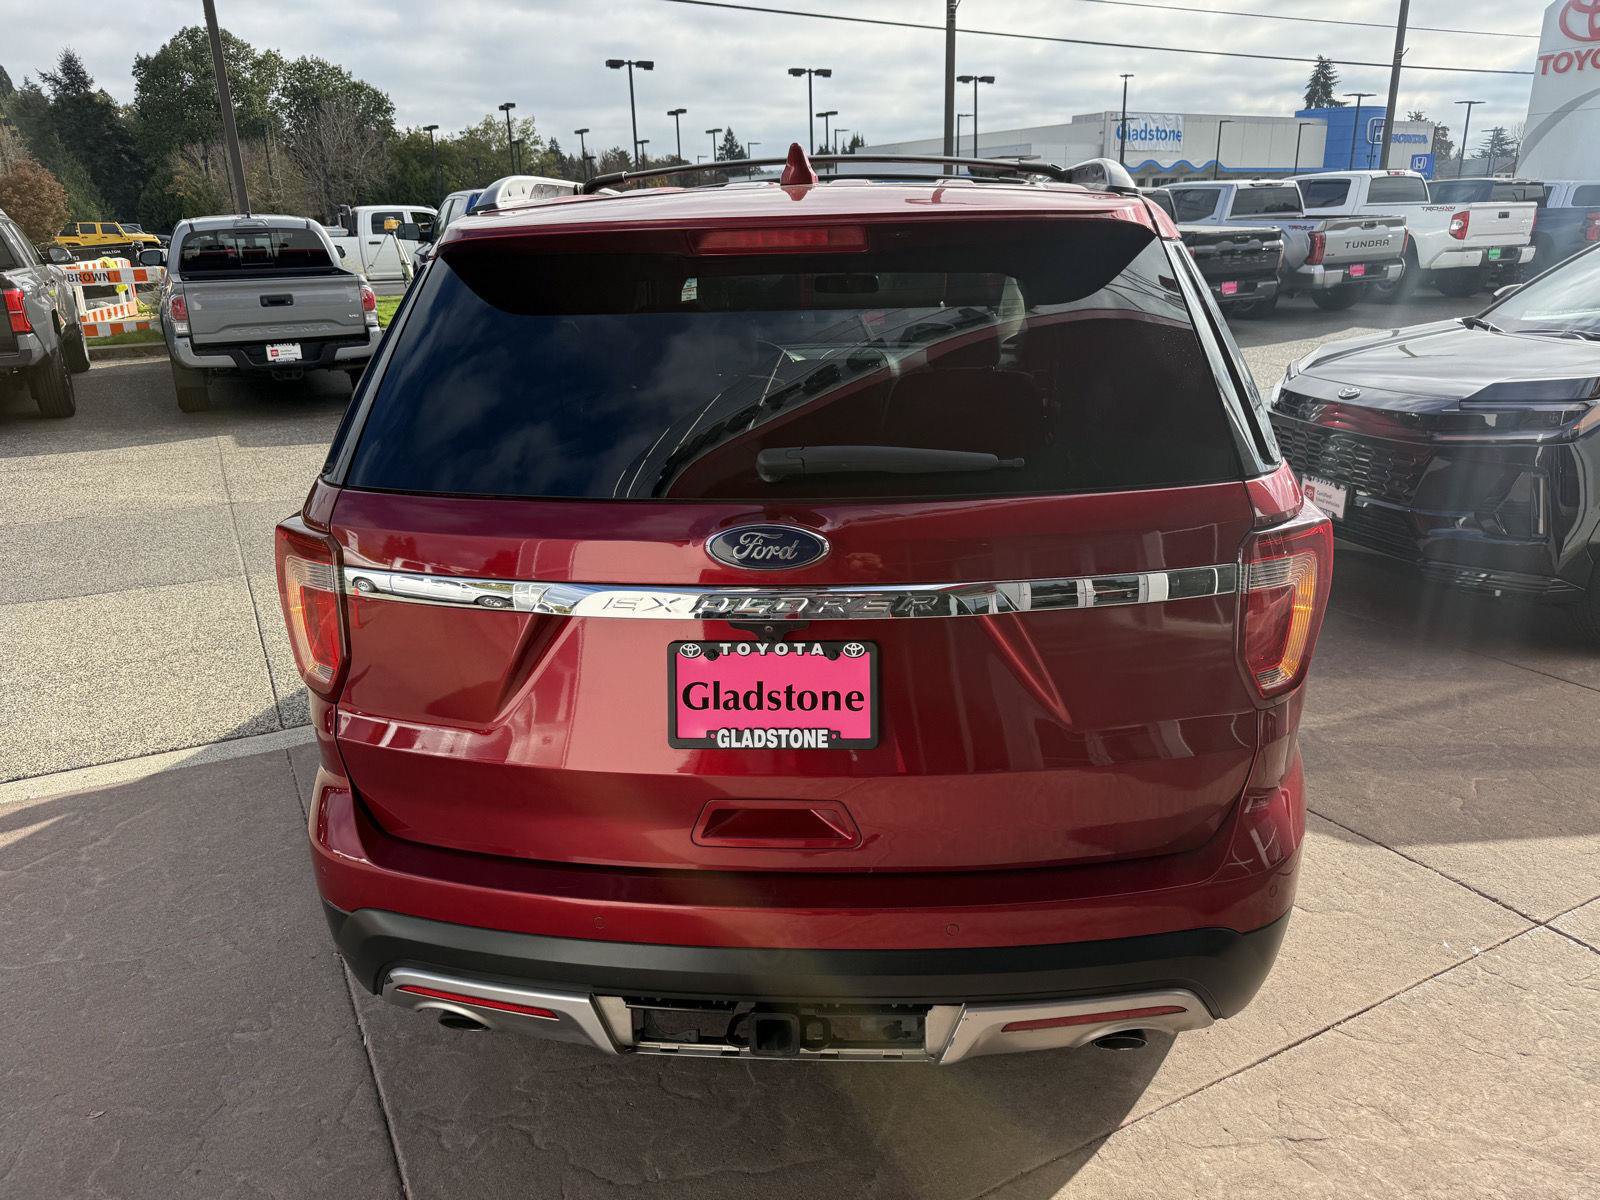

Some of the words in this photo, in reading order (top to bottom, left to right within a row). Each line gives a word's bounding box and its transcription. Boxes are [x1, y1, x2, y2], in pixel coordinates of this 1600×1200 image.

[1345, 239, 1390, 249] TUNDRA
[67, 271, 110, 283] BROWN
[732, 532, 799, 560] Ford
[602, 596, 938, 613] EXPLORER
[719, 642, 824, 656] TOYOTA
[682, 681, 865, 712] Gladstone
[716, 729, 829, 749] GLADSTONE
